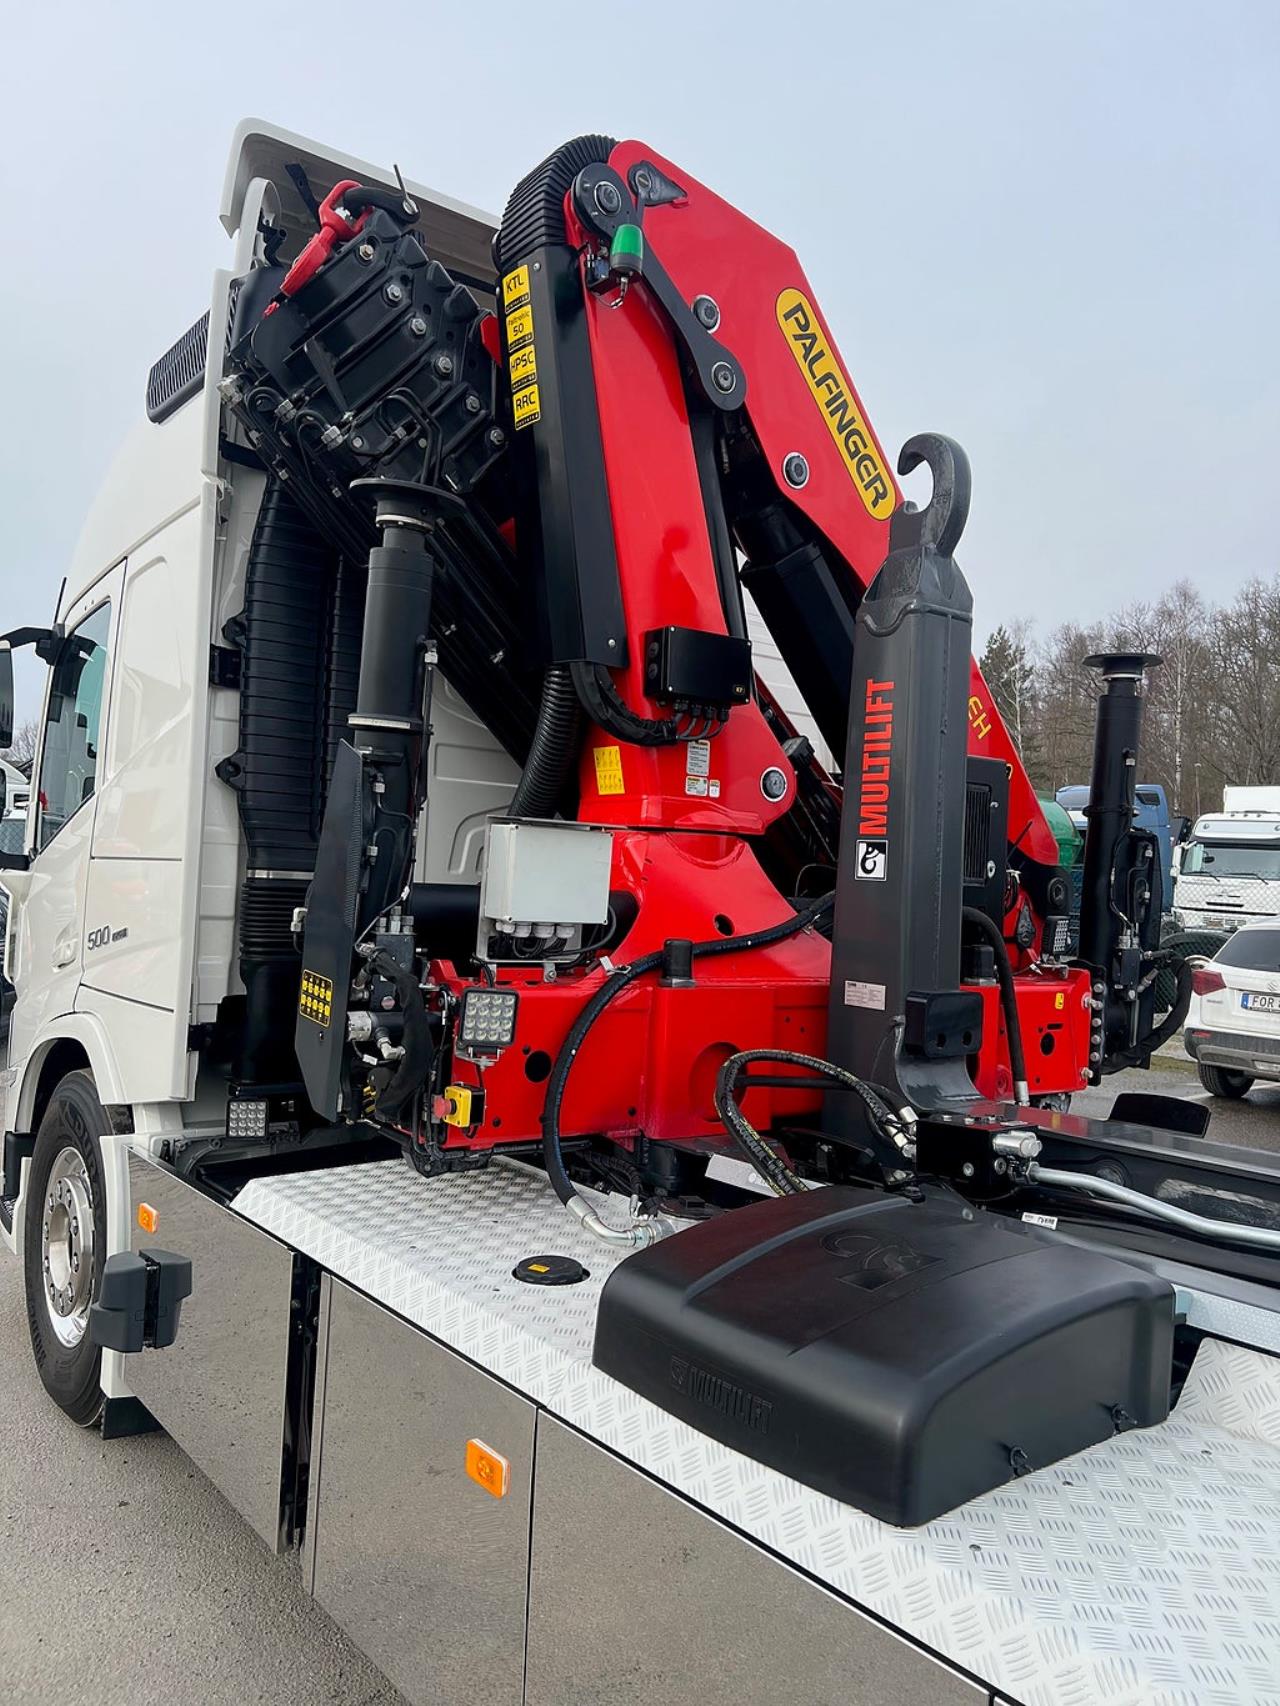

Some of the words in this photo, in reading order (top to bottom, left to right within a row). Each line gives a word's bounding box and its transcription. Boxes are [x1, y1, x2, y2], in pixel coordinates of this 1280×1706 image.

[506, 273, 525, 293] KTL
[513, 322, 525, 337] 50
[516, 391, 536, 411] RRC
[783, 302, 888, 509] PALFINGER
[859, 679, 895, 835] MULTILIFT
[87, 925, 110, 951] 500
[1252, 996, 1275, 1008] FOR
